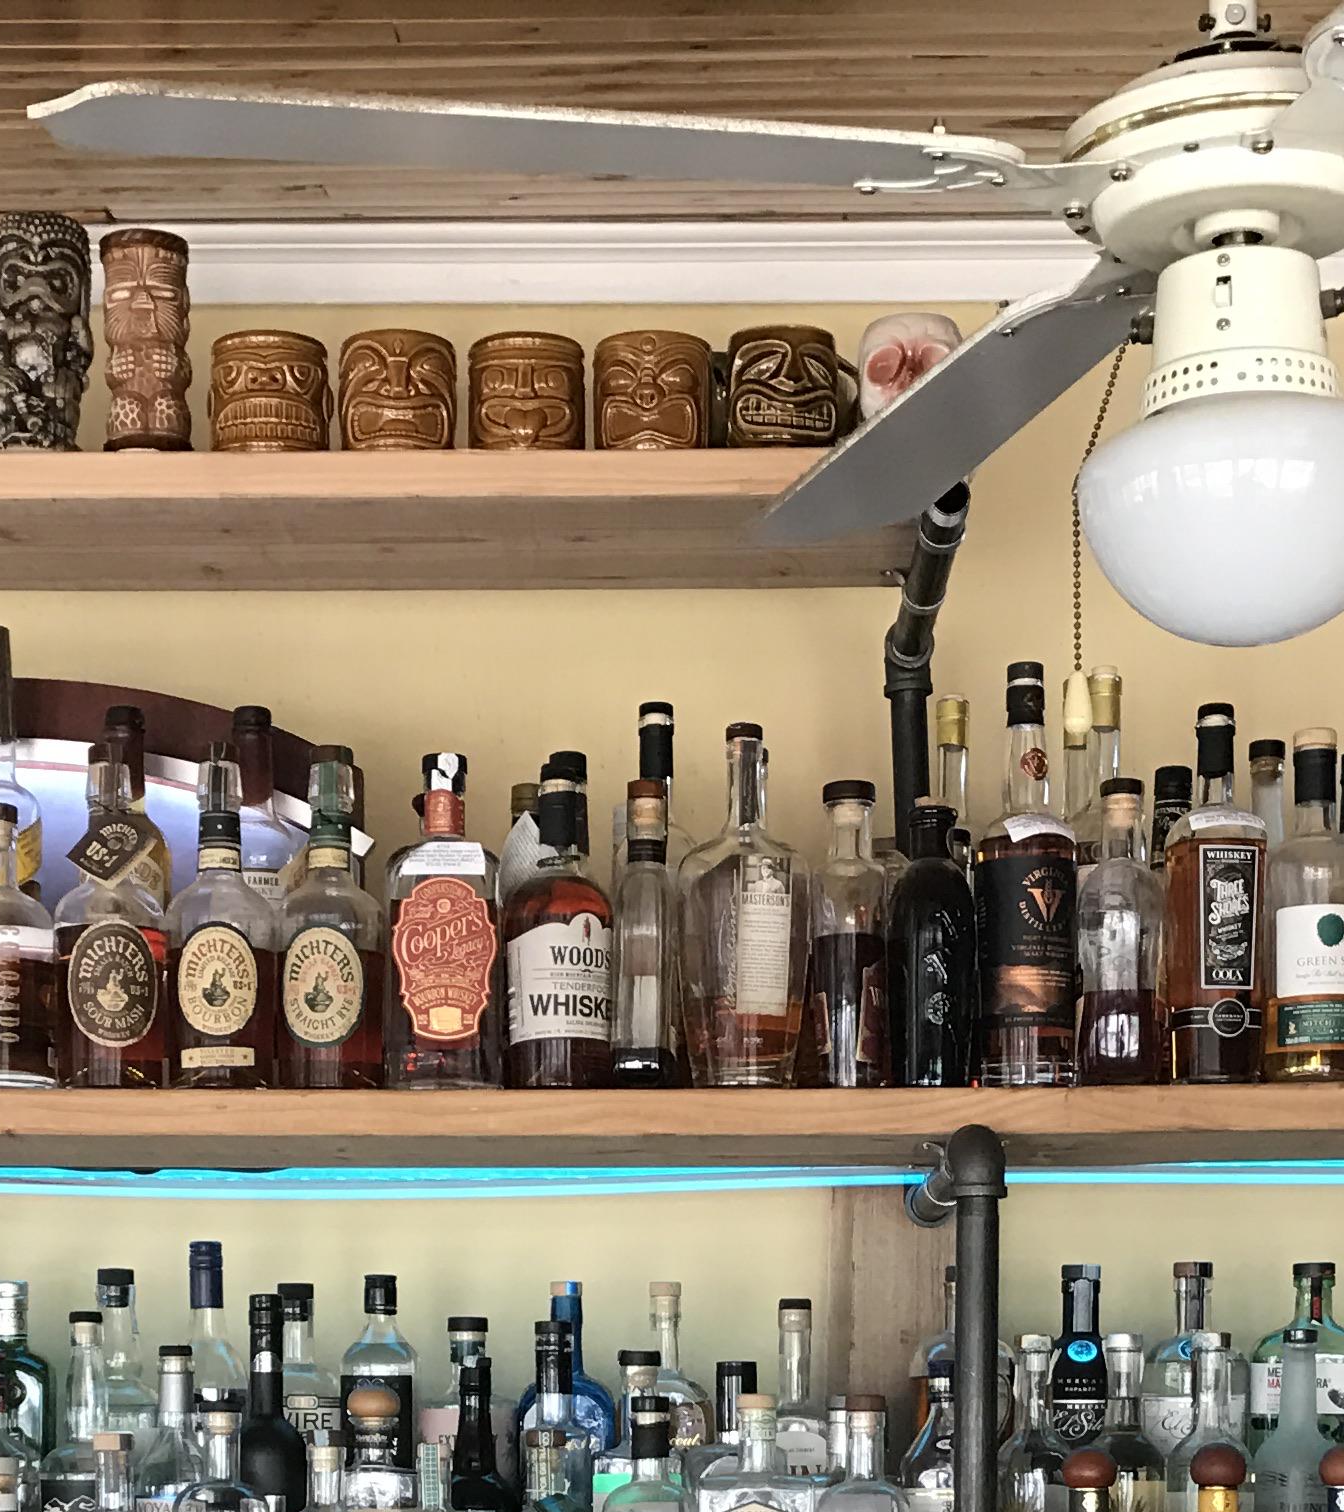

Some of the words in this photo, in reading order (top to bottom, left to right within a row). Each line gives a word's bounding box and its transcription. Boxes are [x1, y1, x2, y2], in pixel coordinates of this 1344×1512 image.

[1206, 850, 1252, 860] WHISKEY
[401, 911, 483, 965] Cooper's
[79, 936, 149, 982] MICHTER'S
[184, 938, 250, 980] MICHTER'S
[289, 939, 355, 985] MICHTER'S
[1297, 955, 1338, 967] GREEN
[83, 1001, 114, 1028] SOUR
[115, 1003, 146, 1030] MASH
[187, 995, 249, 1025] BOURBON
[290, 997, 336, 1030] STRAIGHT
[529, 993, 612, 1020] WHISKE
